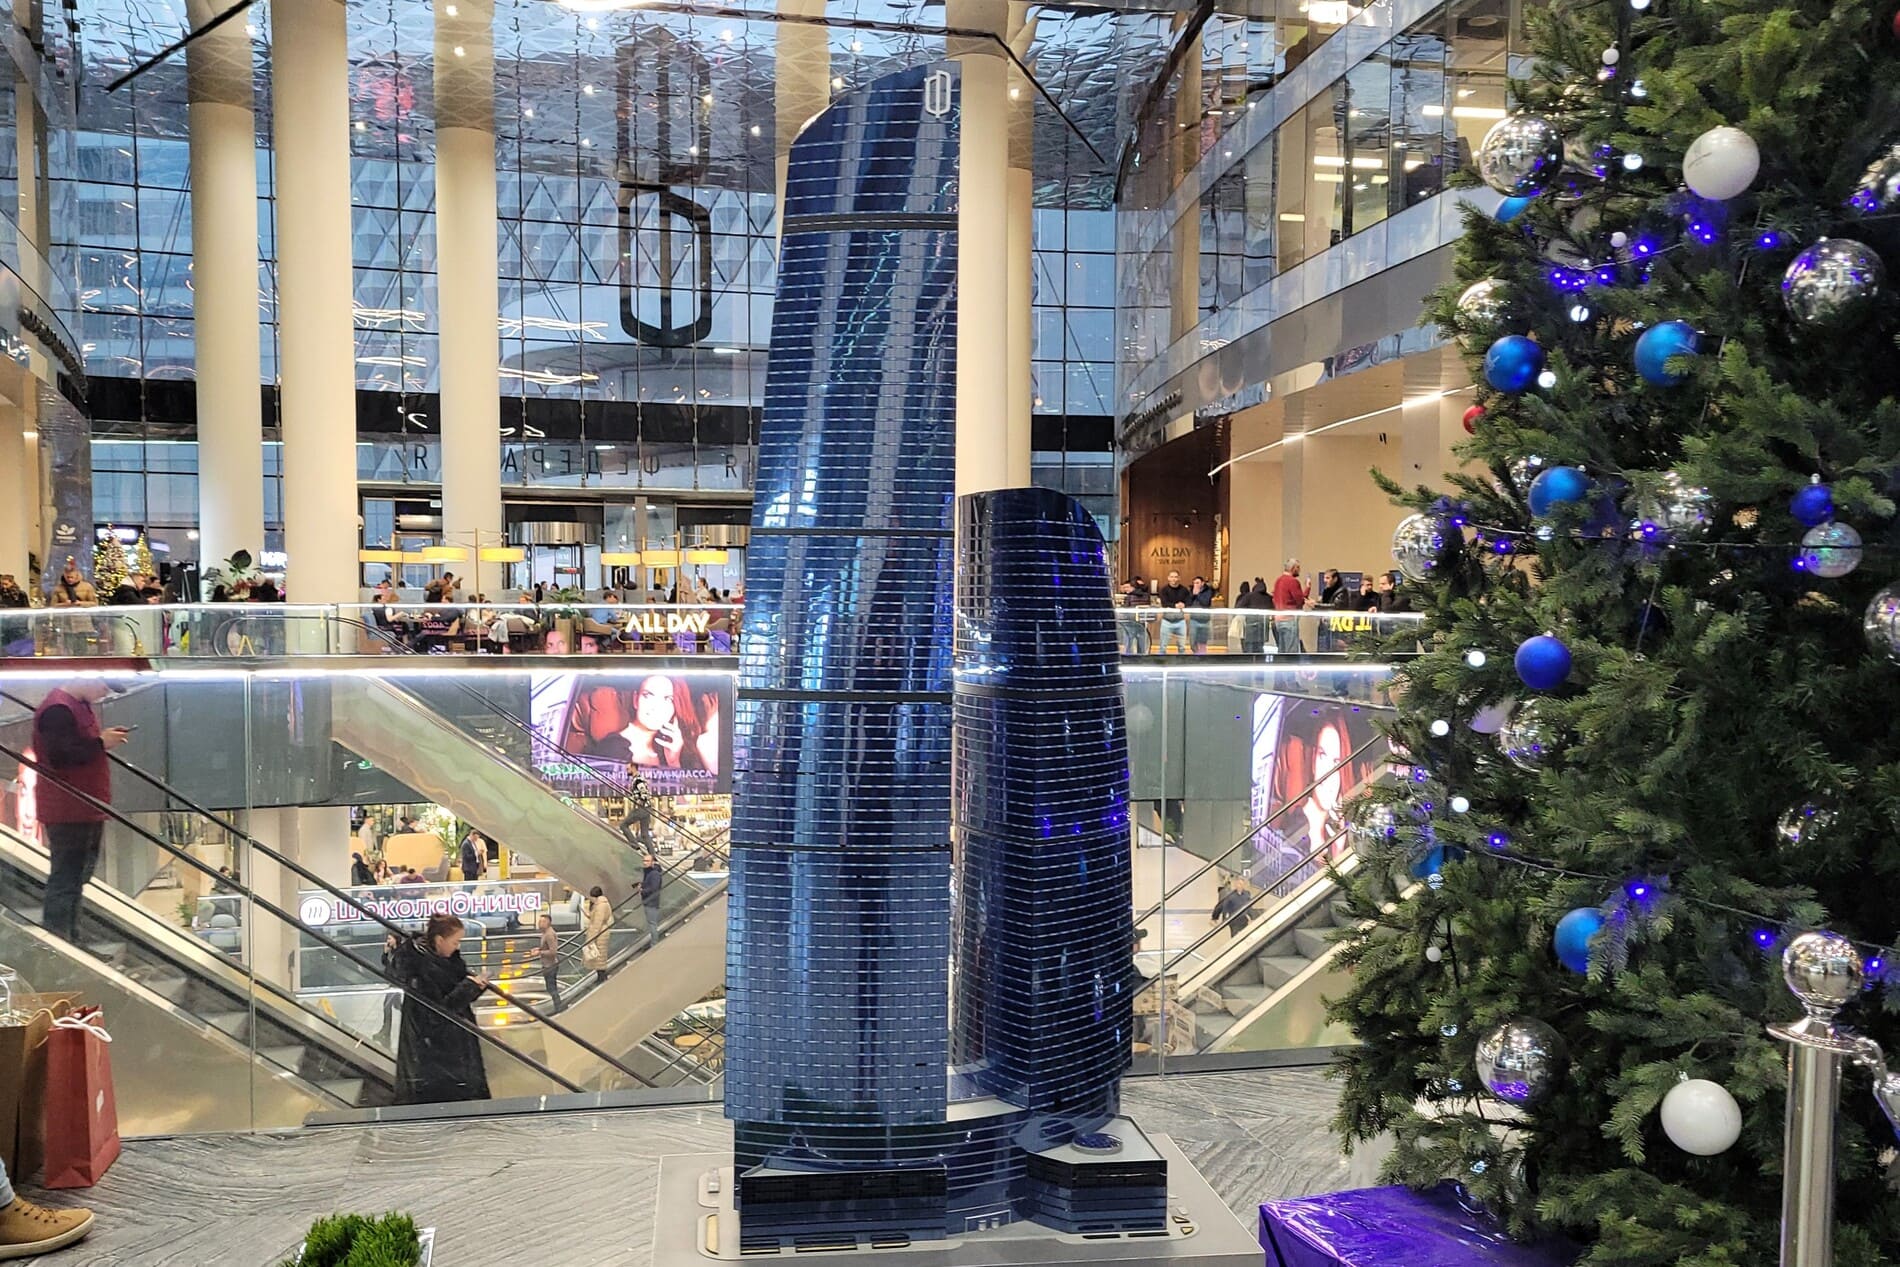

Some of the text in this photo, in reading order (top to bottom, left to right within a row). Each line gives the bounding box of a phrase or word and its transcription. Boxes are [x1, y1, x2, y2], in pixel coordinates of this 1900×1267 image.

[1151, 547, 1192, 557] ALL DAY
[625, 611, 710, 633] ALL DAY
[335, 891, 542, 922] Шоколадница
